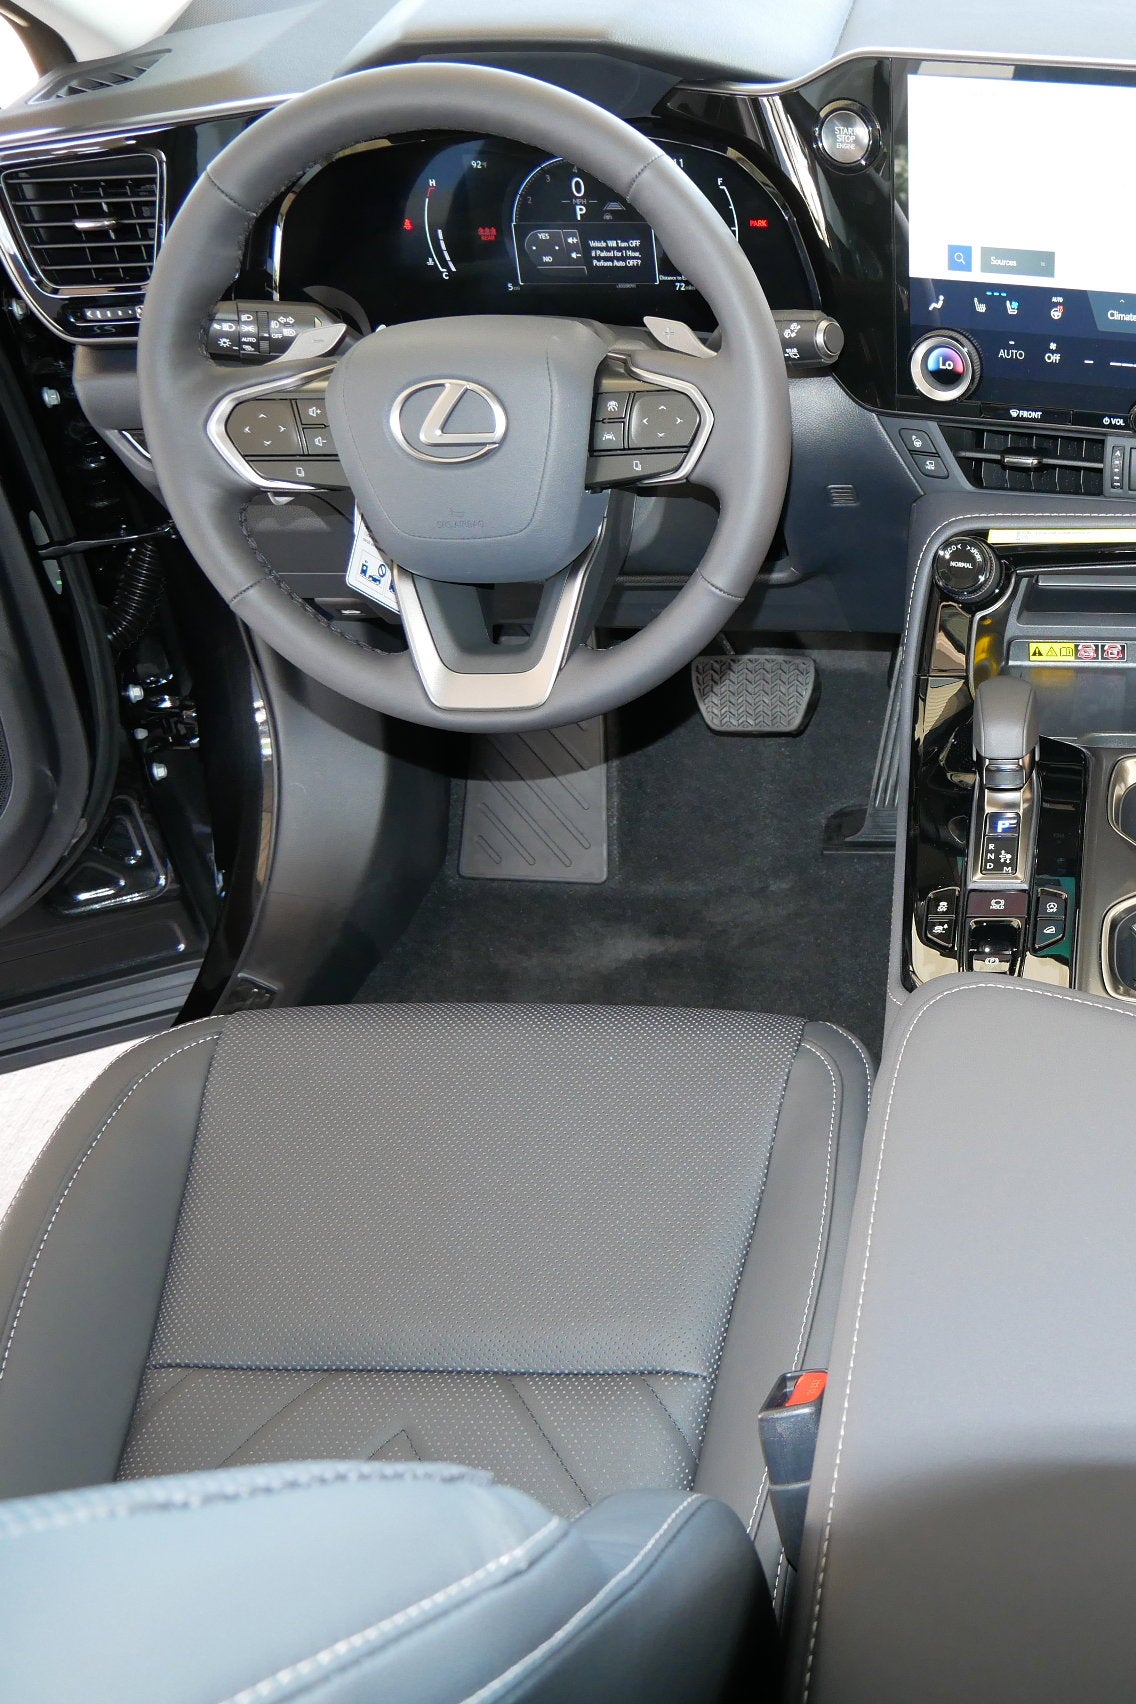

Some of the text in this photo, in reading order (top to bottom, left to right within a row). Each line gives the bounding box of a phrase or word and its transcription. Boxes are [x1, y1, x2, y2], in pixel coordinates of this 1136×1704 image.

[835, 126, 857, 136] START
[836, 134, 856, 143] STOP
[428, 179, 436, 187] H
[717, 178, 723, 186] F
[576, 205, 586, 221] P
[990, 256, 1017, 268] Sources
[442, 272, 449, 280] C
[998, 349, 1025, 360] AUTO
[1044, 352, 1061, 364] Off
[939, 357, 954, 370] Lo
[1019, 410, 1042, 419] FRONT
[1111, 417, 1125, 426] VOL
[950, 561, 973, 569] NORMAL
[997, 820, 1010, 833] P
[987, 852, 995, 860] N
[986, 862, 994, 870] D
